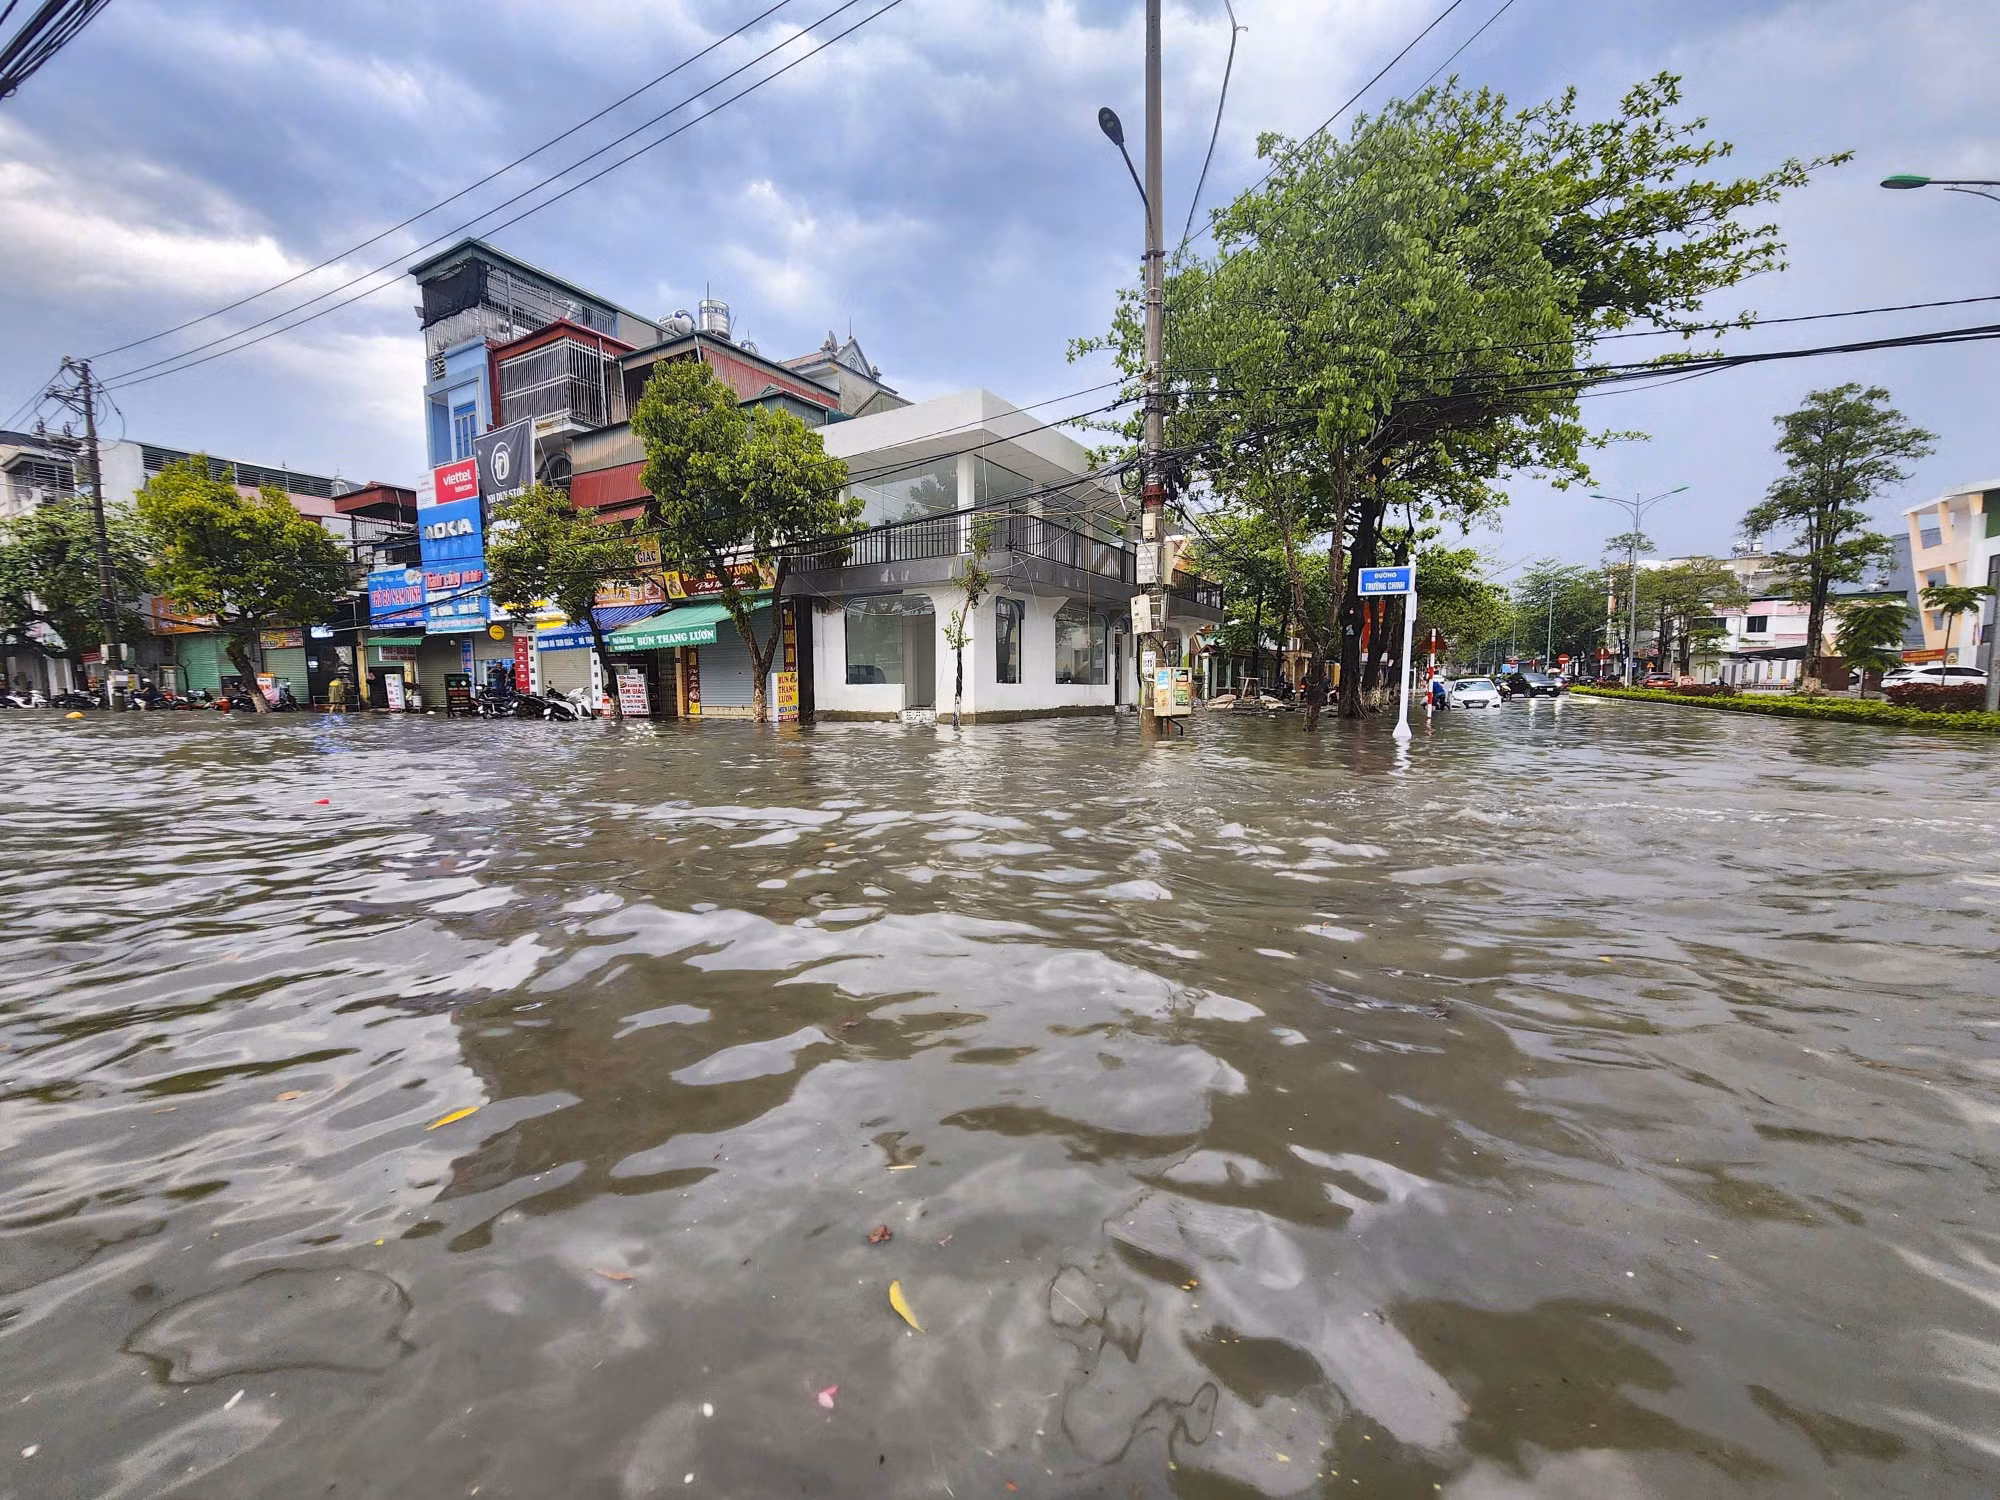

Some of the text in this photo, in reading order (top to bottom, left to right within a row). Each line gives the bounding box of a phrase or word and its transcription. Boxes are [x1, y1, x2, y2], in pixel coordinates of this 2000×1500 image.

[443, 469, 472, 486] viettel
[454, 484, 473, 493] telecom
[1365, 580, 1406, 591] TRƯỜNG CHINH
[391, 588, 406, 606] NAM
[637, 630, 714, 646] BÚN THANG LƯƠN
[778, 685, 796, 693] THANG
